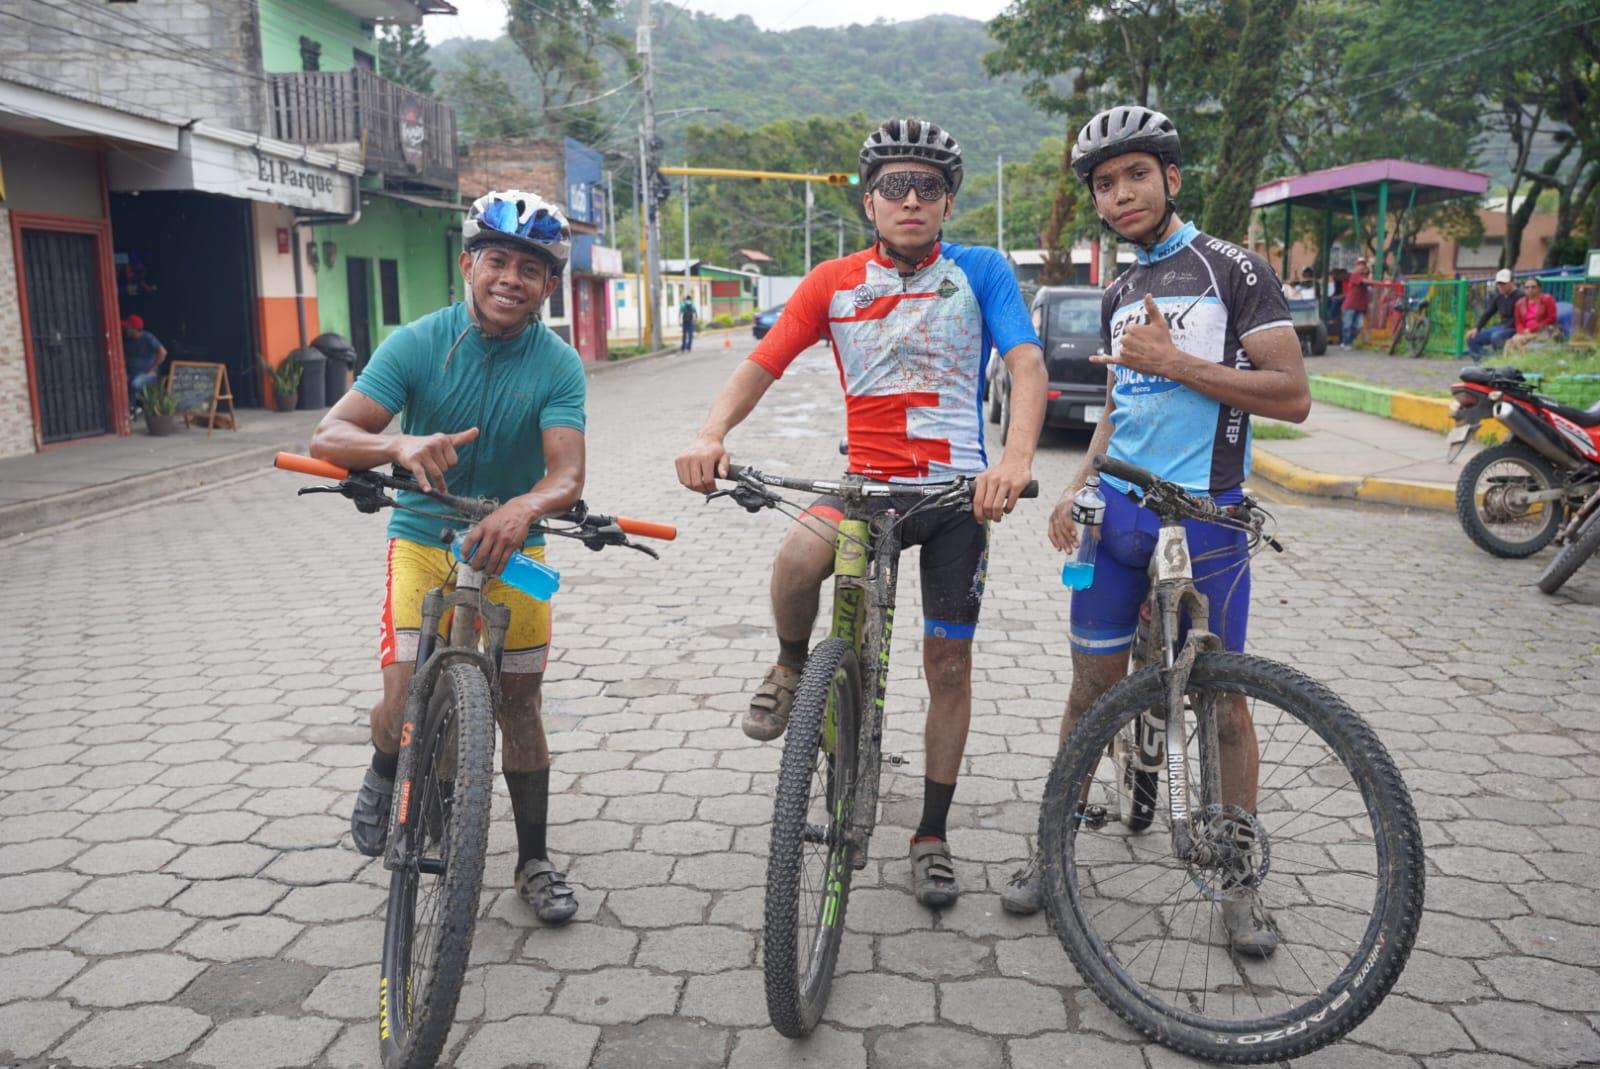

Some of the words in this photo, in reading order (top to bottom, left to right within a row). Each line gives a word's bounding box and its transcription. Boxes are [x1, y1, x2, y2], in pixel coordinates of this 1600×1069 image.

[258, 157, 276, 184] El
[279, 161, 333, 198] Parque
[1205, 239, 1257, 286] latexco
[1225, 407, 1243, 444] STEP
[1168, 755, 1188, 820] ROCKSHOX
[1353, 944, 1382, 988] vittoria
[1236, 990, 1351, 1045] BARZO
